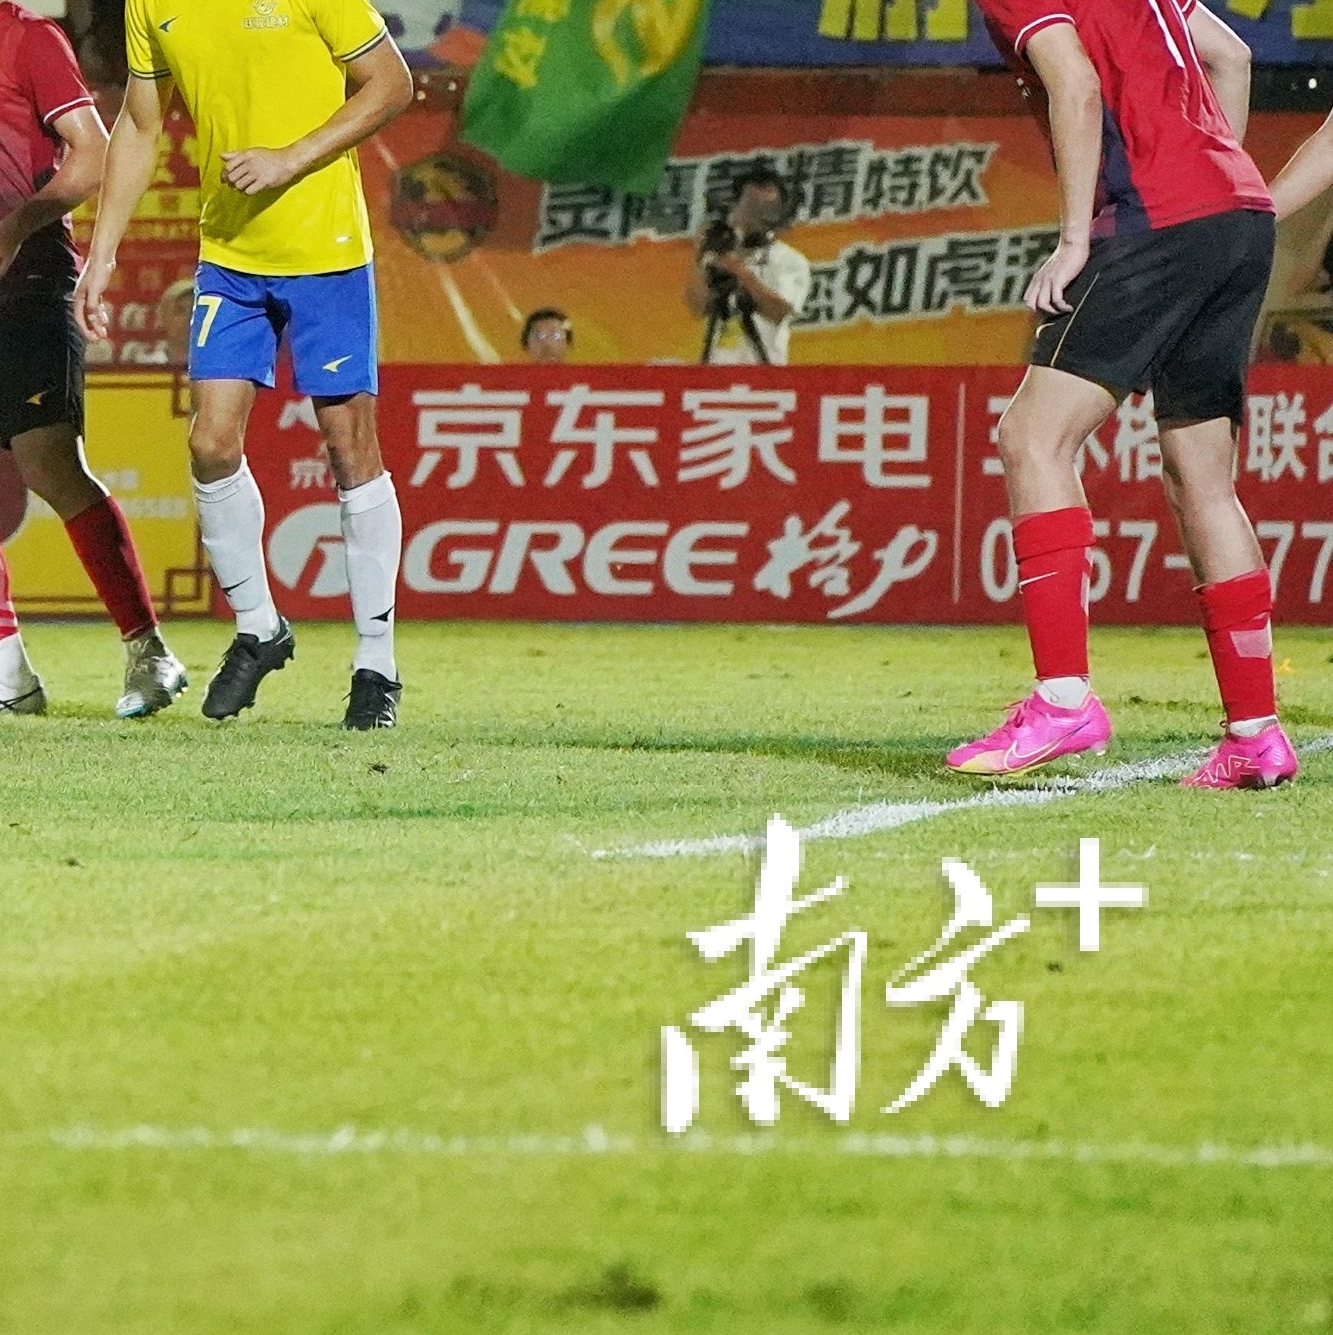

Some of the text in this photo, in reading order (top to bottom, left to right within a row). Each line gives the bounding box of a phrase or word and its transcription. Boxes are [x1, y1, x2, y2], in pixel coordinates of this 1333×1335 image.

[288, 458, 336, 490] 京
[410, 384, 931, 488] 京东家电
[404, 519, 749, 597] GREE
